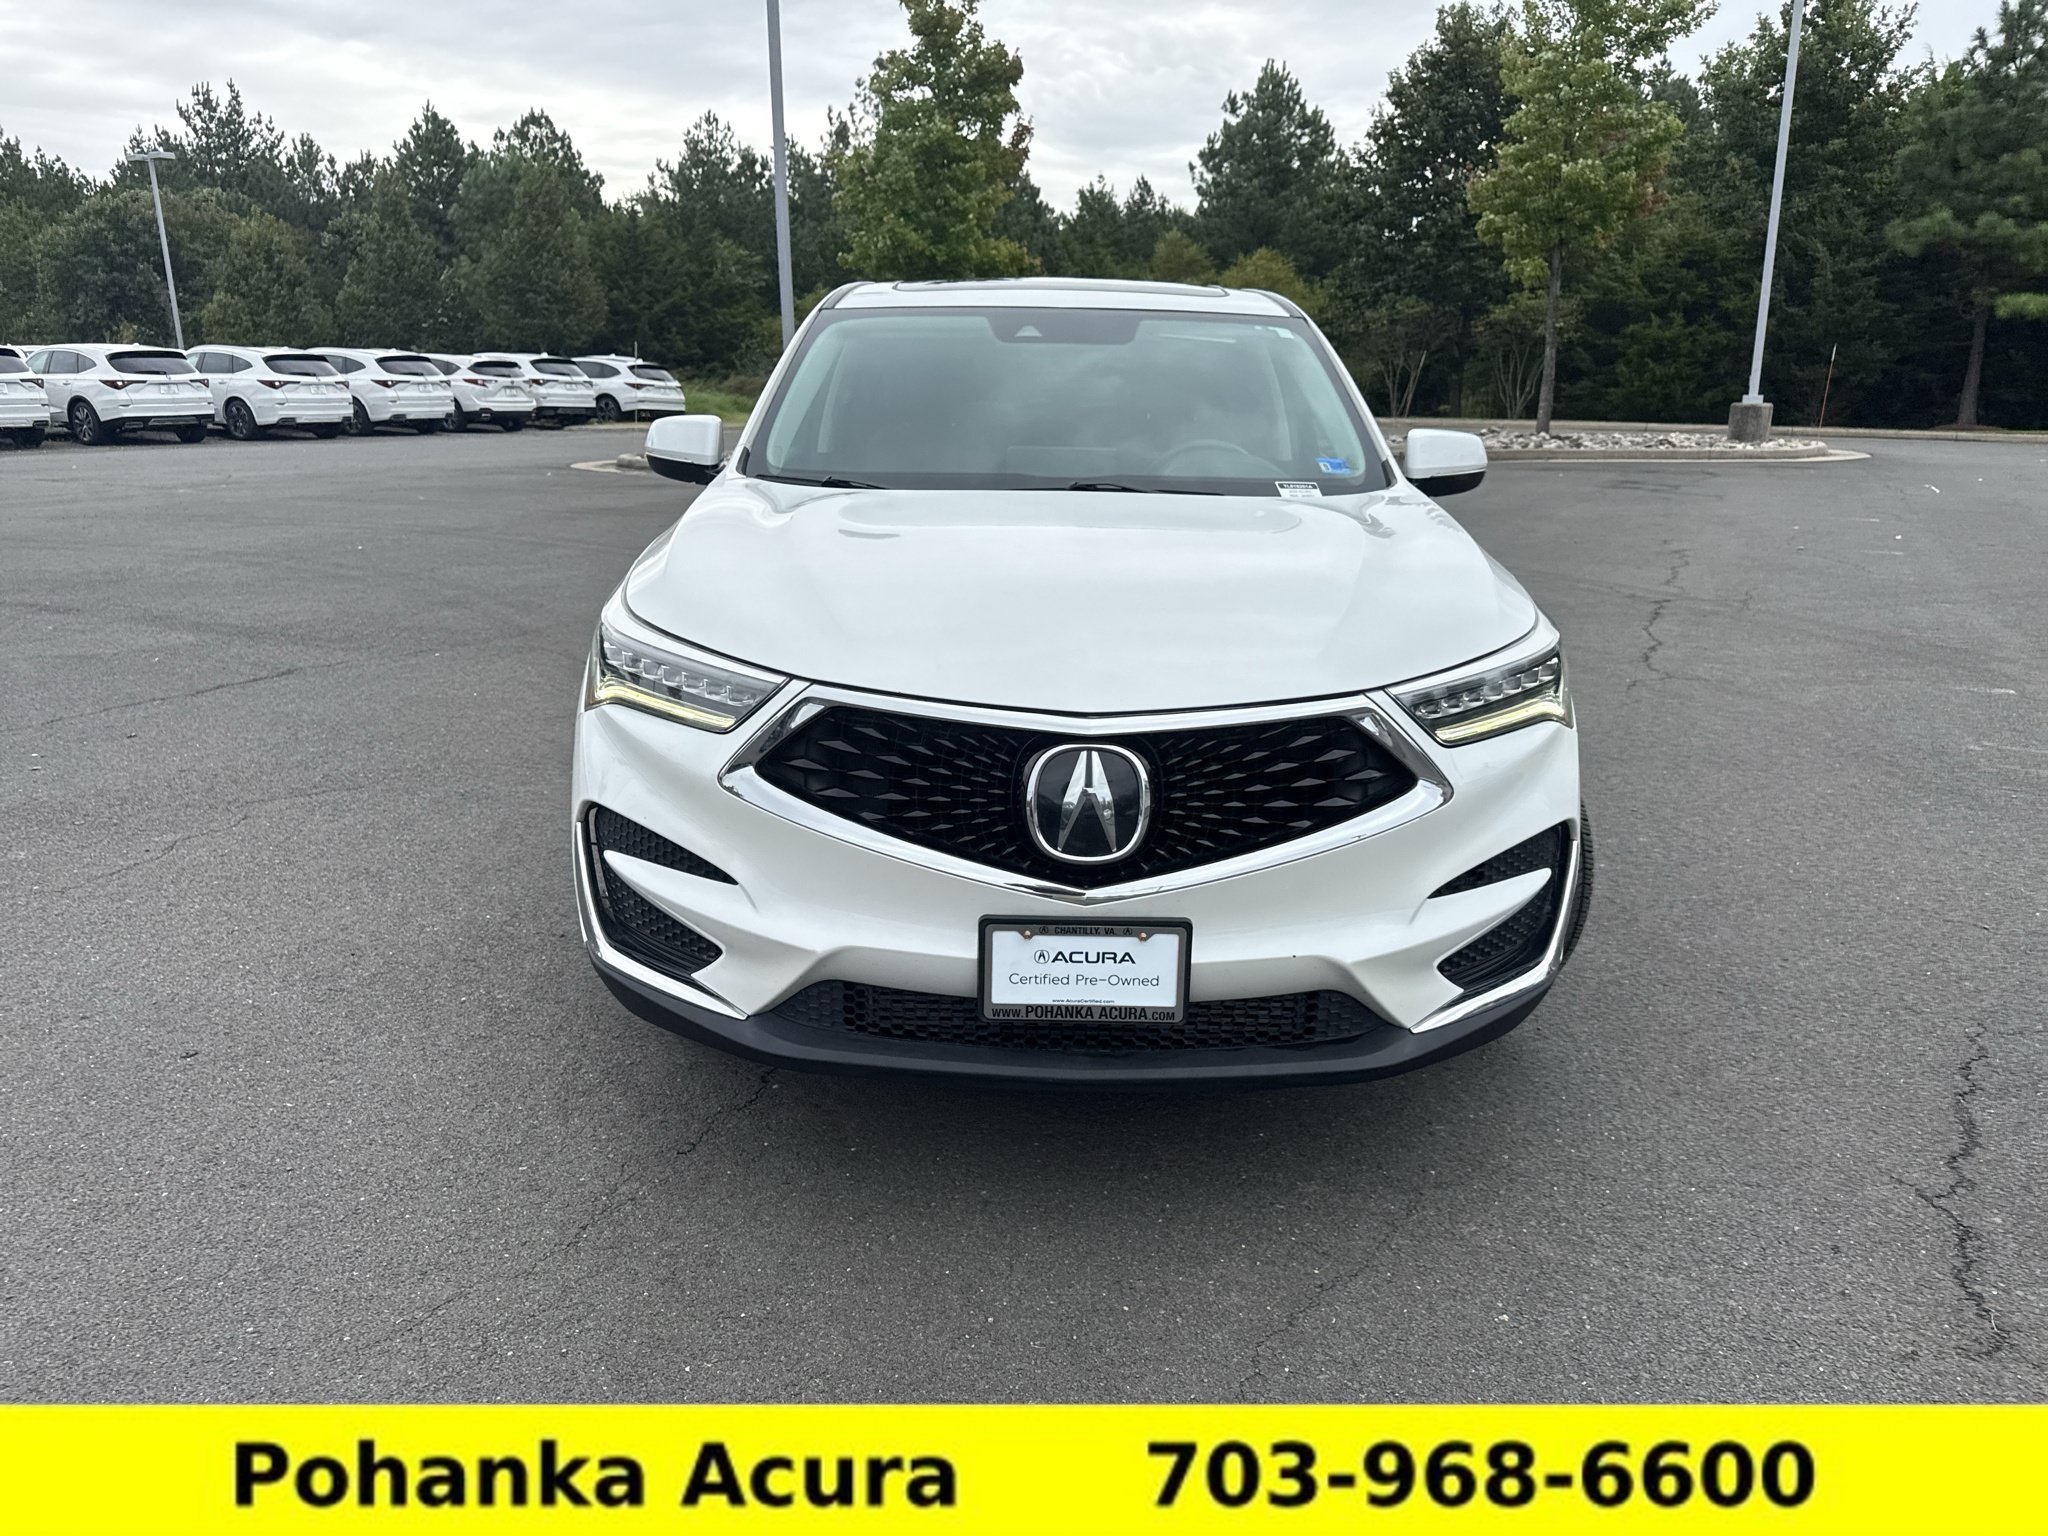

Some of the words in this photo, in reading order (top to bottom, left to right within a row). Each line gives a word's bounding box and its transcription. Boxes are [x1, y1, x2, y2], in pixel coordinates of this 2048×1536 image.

[1051, 951, 1136, 965] ACURA
[1008, 973, 1070, 986] Certified
[1075, 974, 1160, 987] Pre-Owned
